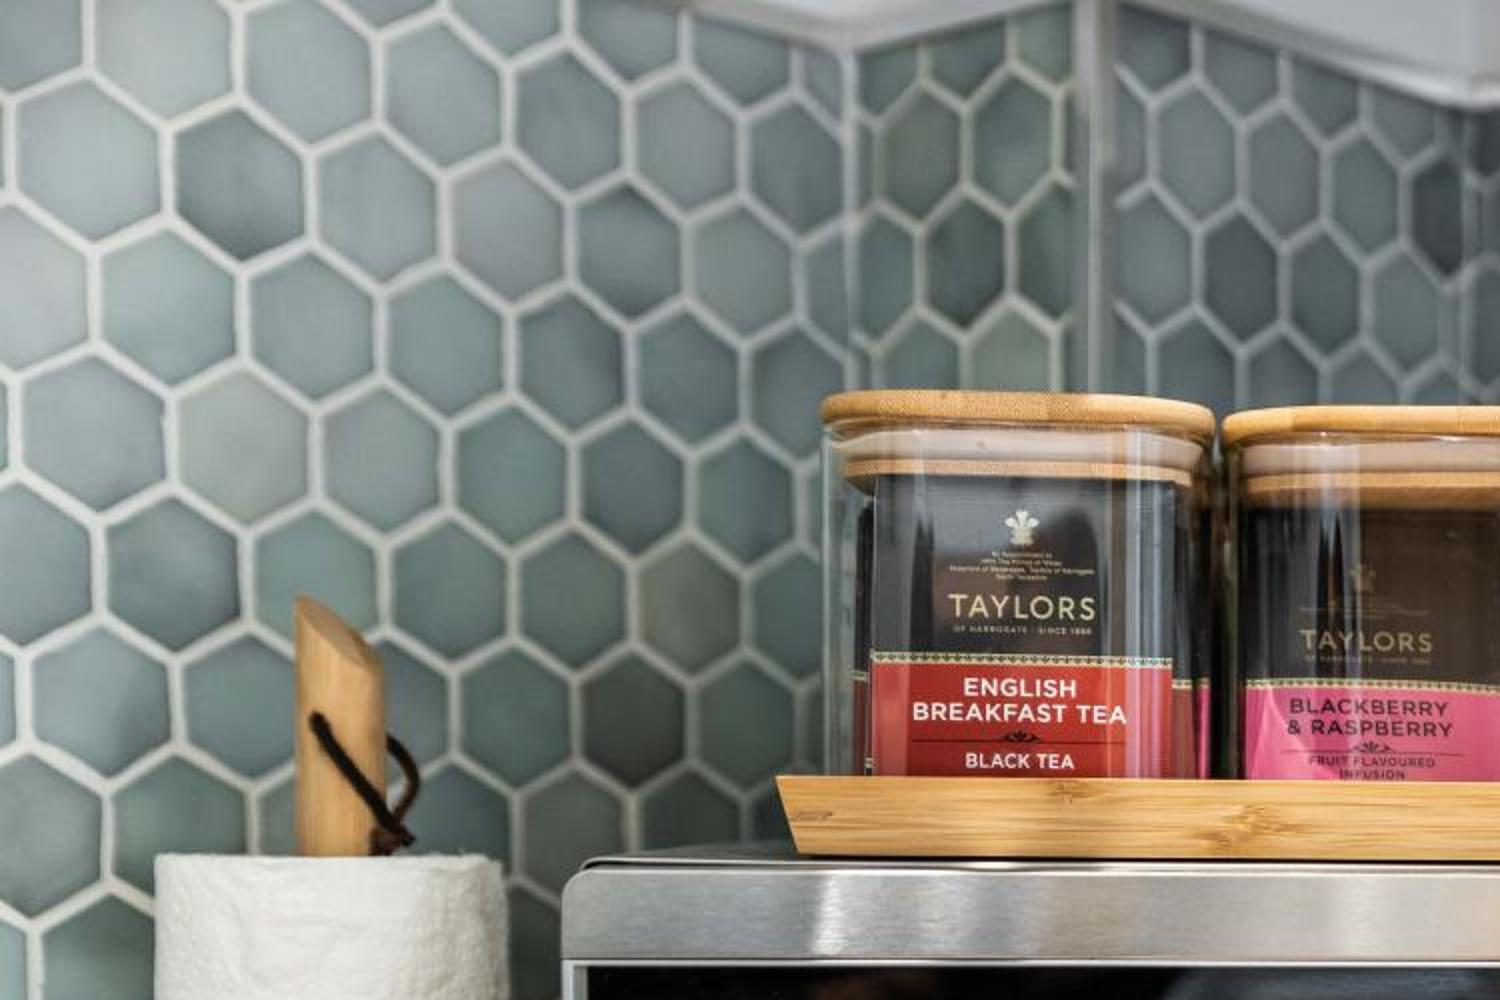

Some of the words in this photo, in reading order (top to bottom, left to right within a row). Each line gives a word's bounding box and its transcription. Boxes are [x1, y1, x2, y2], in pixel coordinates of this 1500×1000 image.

[948, 593, 1095, 621] TAYLORS
[1299, 629, 1433, 653] TAYLORS
[963, 677, 1076, 698] ENGLISH
[913, 701, 1067, 723] BREAKFAST
[1076, 704, 1127, 725] TEA
[1289, 698, 1449, 717] BLACKBERRY
[1287, 719, 1299, 735] &
[1311, 719, 1453, 737] RASPBERRY
[965, 753, 1030, 769] BLACK
[1036, 753, 1075, 770] TEA
[1309, 755, 1349, 767] FRUIT
[1353, 755, 1436, 768] FLAVOURED
[1340, 768, 1405, 781] INFUSION
